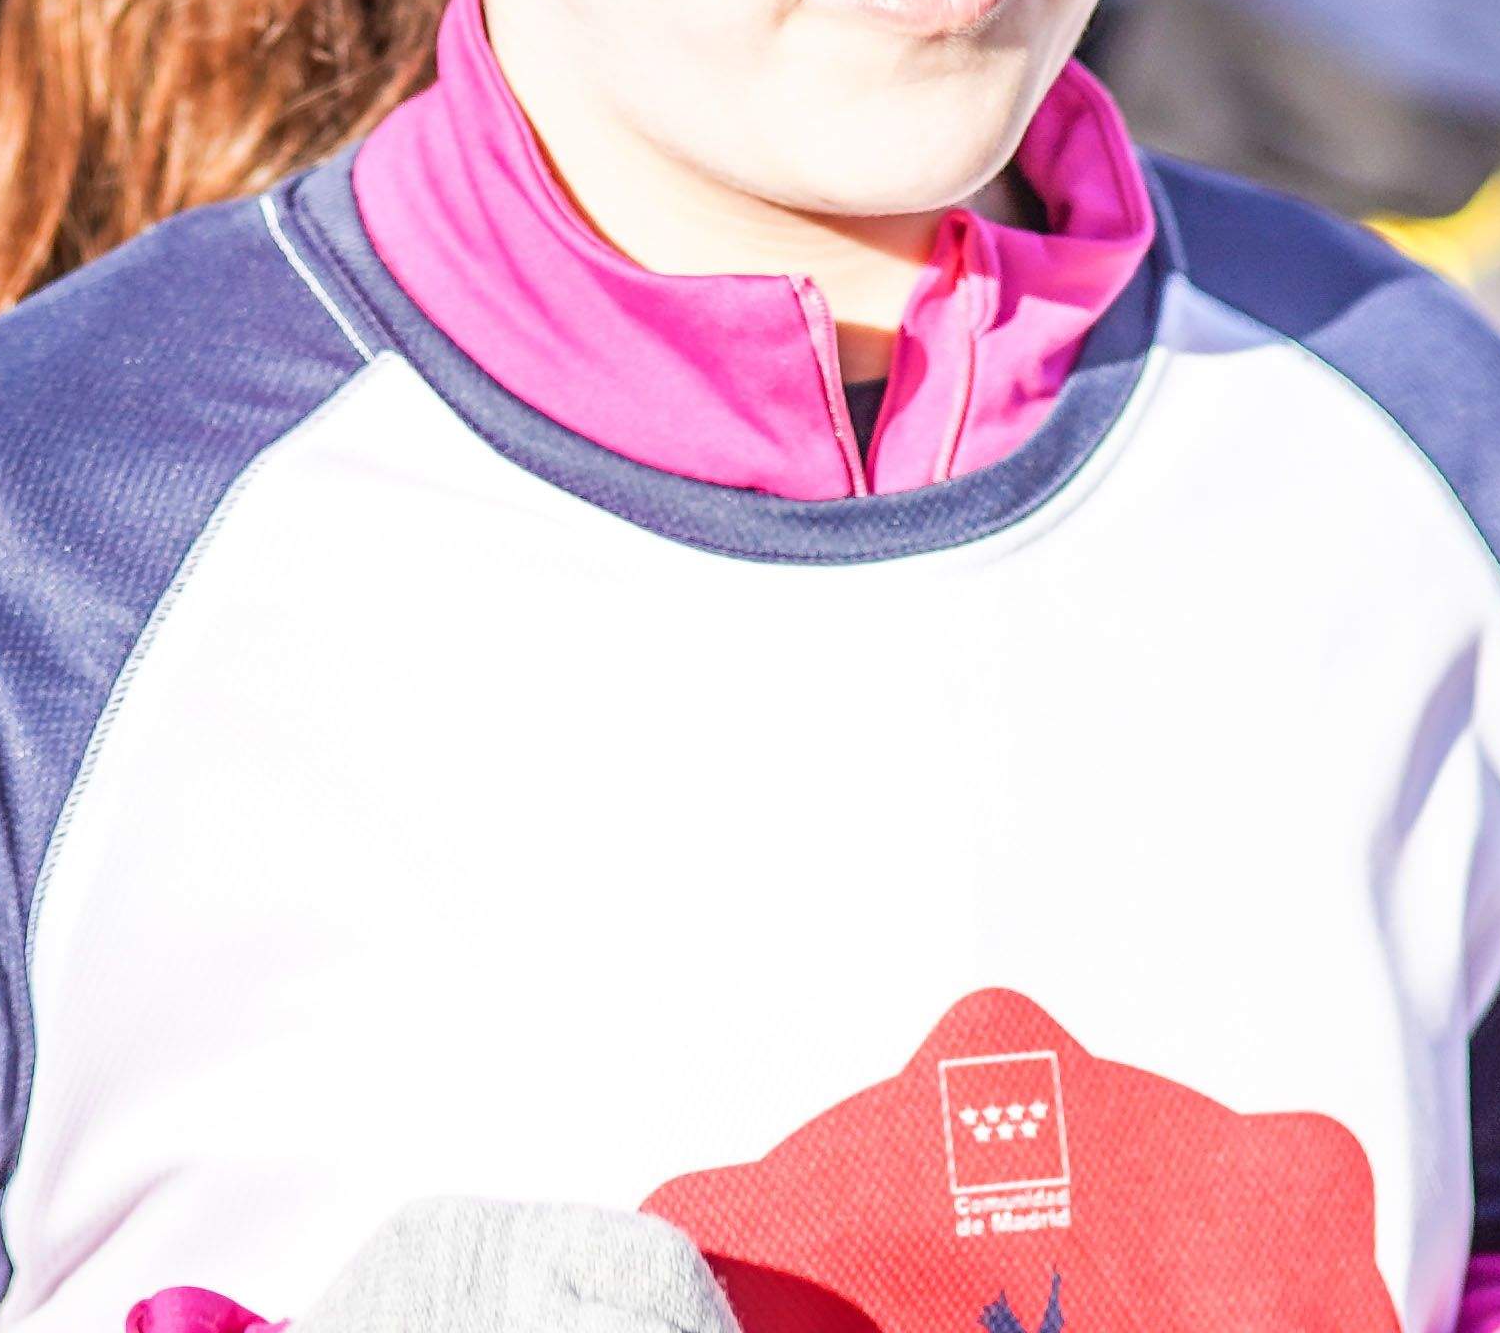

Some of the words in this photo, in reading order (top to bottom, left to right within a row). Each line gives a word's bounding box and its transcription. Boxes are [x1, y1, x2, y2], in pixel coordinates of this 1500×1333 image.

[954, 1187, 1070, 1215] Comunidad
[956, 1216, 985, 1237] de
[991, 1207, 1070, 1234] Madrid
